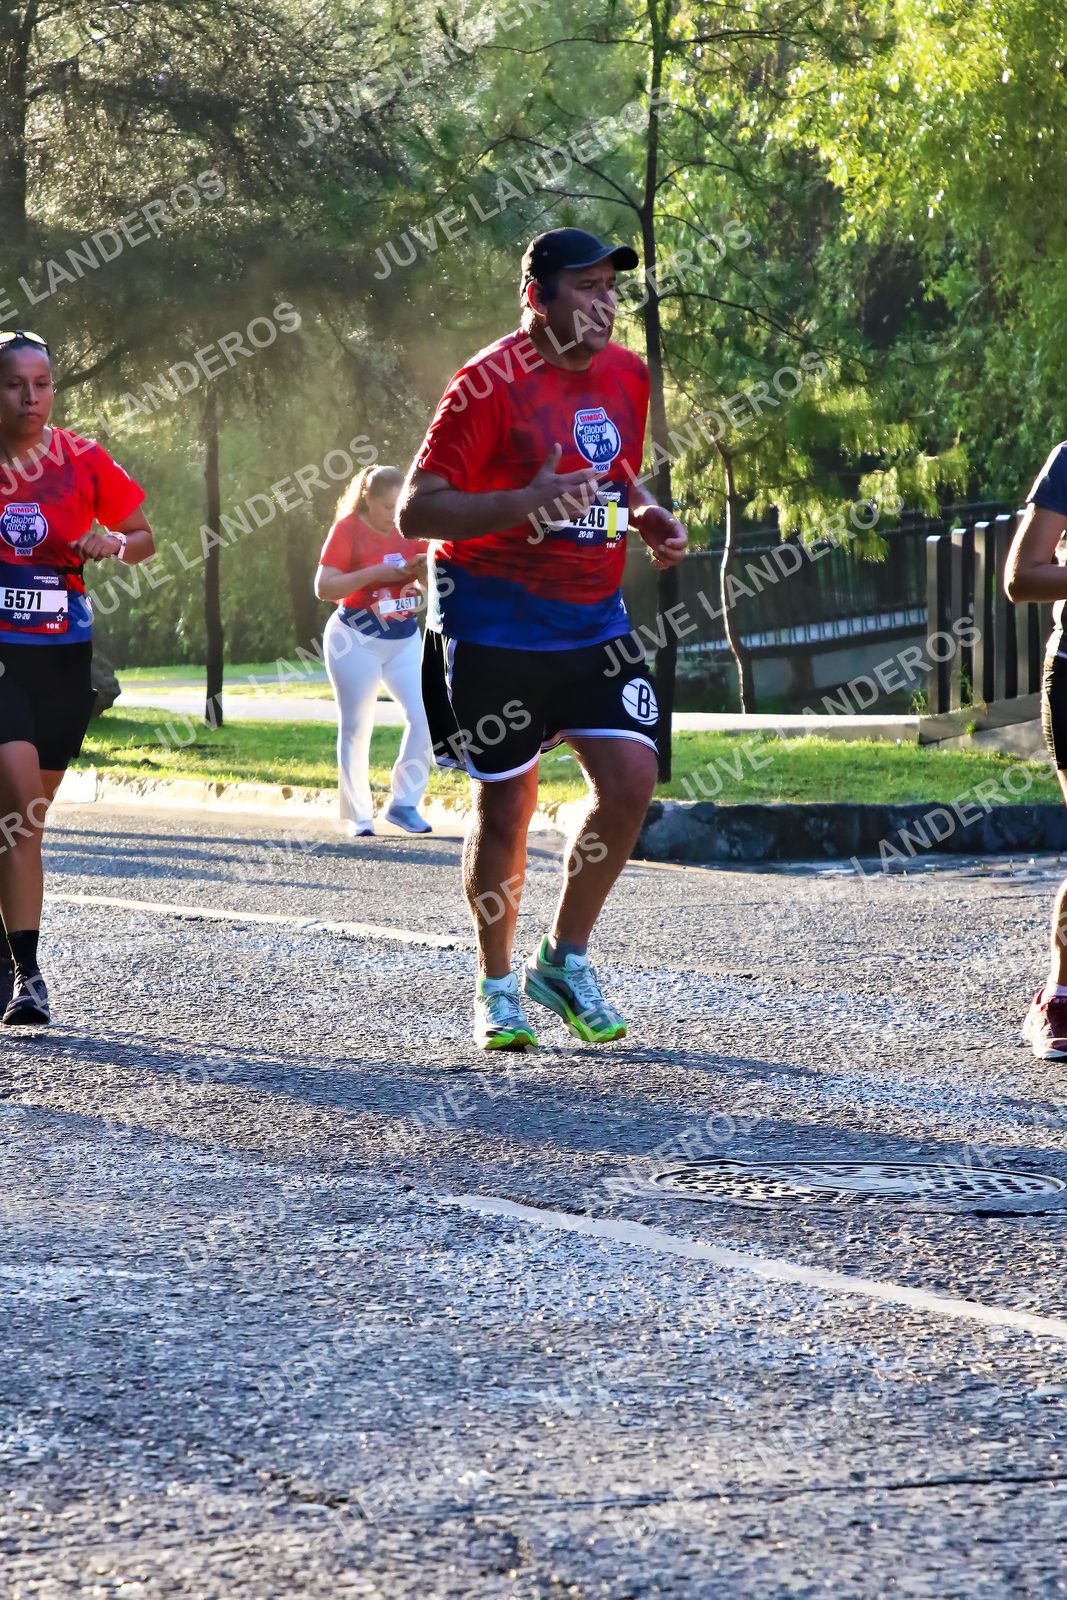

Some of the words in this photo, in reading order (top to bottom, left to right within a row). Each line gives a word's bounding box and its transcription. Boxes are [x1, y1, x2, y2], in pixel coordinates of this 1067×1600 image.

[584, 423, 606, 435] Global
[582, 434, 600, 444] Race
[11, 515, 36, 525] Global
[6, 523, 26, 532] Race
[4, 589, 42, 610] 5571
[13, 612, 31, 620] 20-26
[637, 683, 651, 719] B
